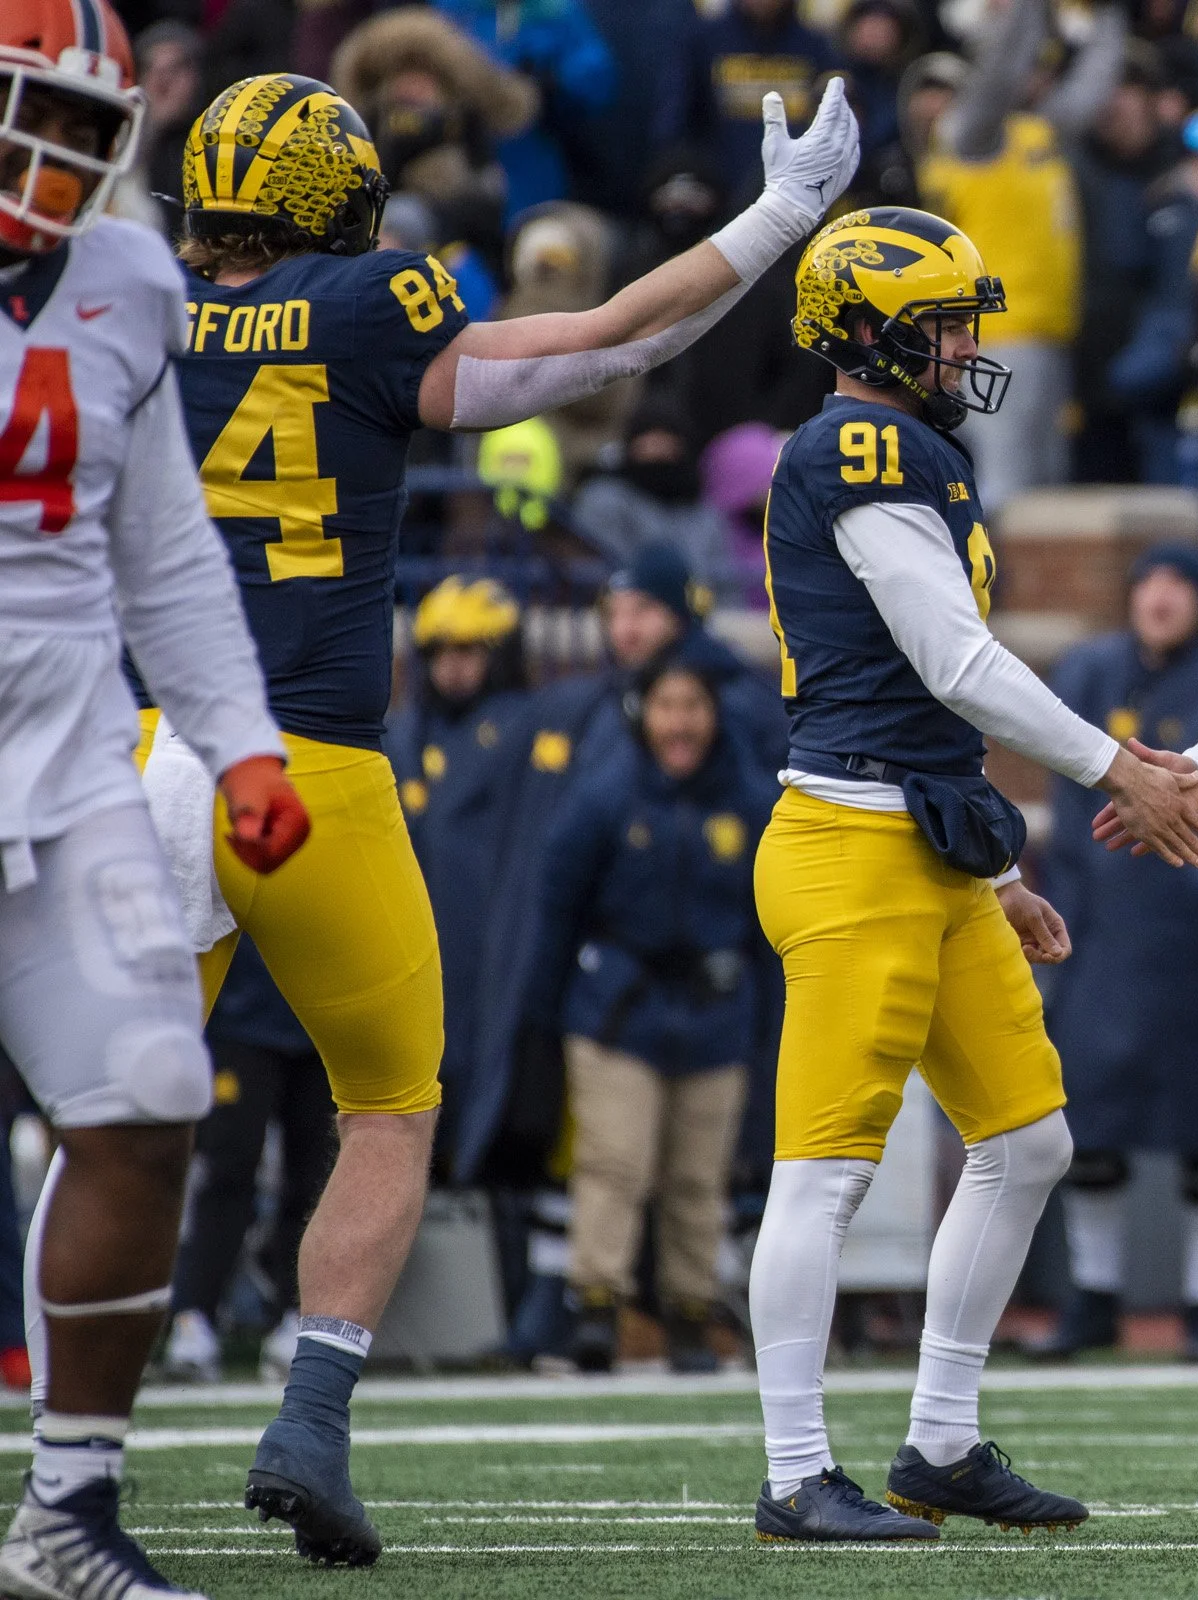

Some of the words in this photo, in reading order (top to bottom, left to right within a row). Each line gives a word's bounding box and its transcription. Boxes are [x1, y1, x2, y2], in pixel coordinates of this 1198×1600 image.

[390, 255, 466, 333] 84
[876, 358, 930, 400] MICHIGN
[0, 346, 79, 533] 4
[197, 364, 344, 582] 4
[839, 422, 904, 485] 91
